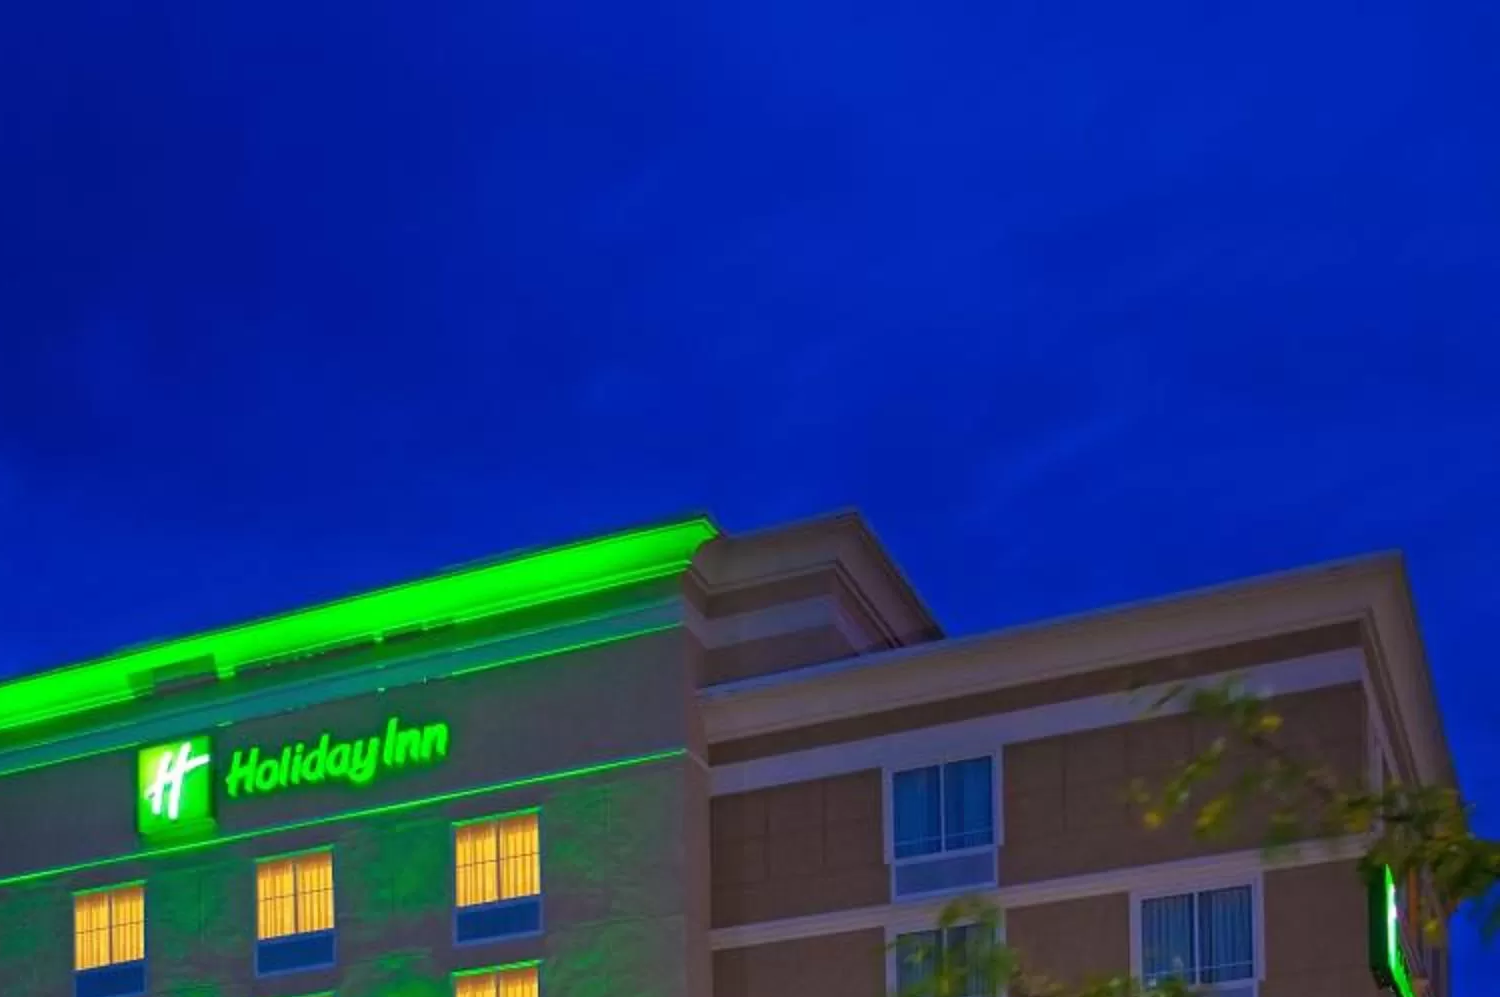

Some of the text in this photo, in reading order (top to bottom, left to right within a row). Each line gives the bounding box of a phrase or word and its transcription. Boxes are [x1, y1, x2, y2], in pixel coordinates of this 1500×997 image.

[145, 741, 210, 820] H
[226, 717, 447, 796] Holiday Inn
